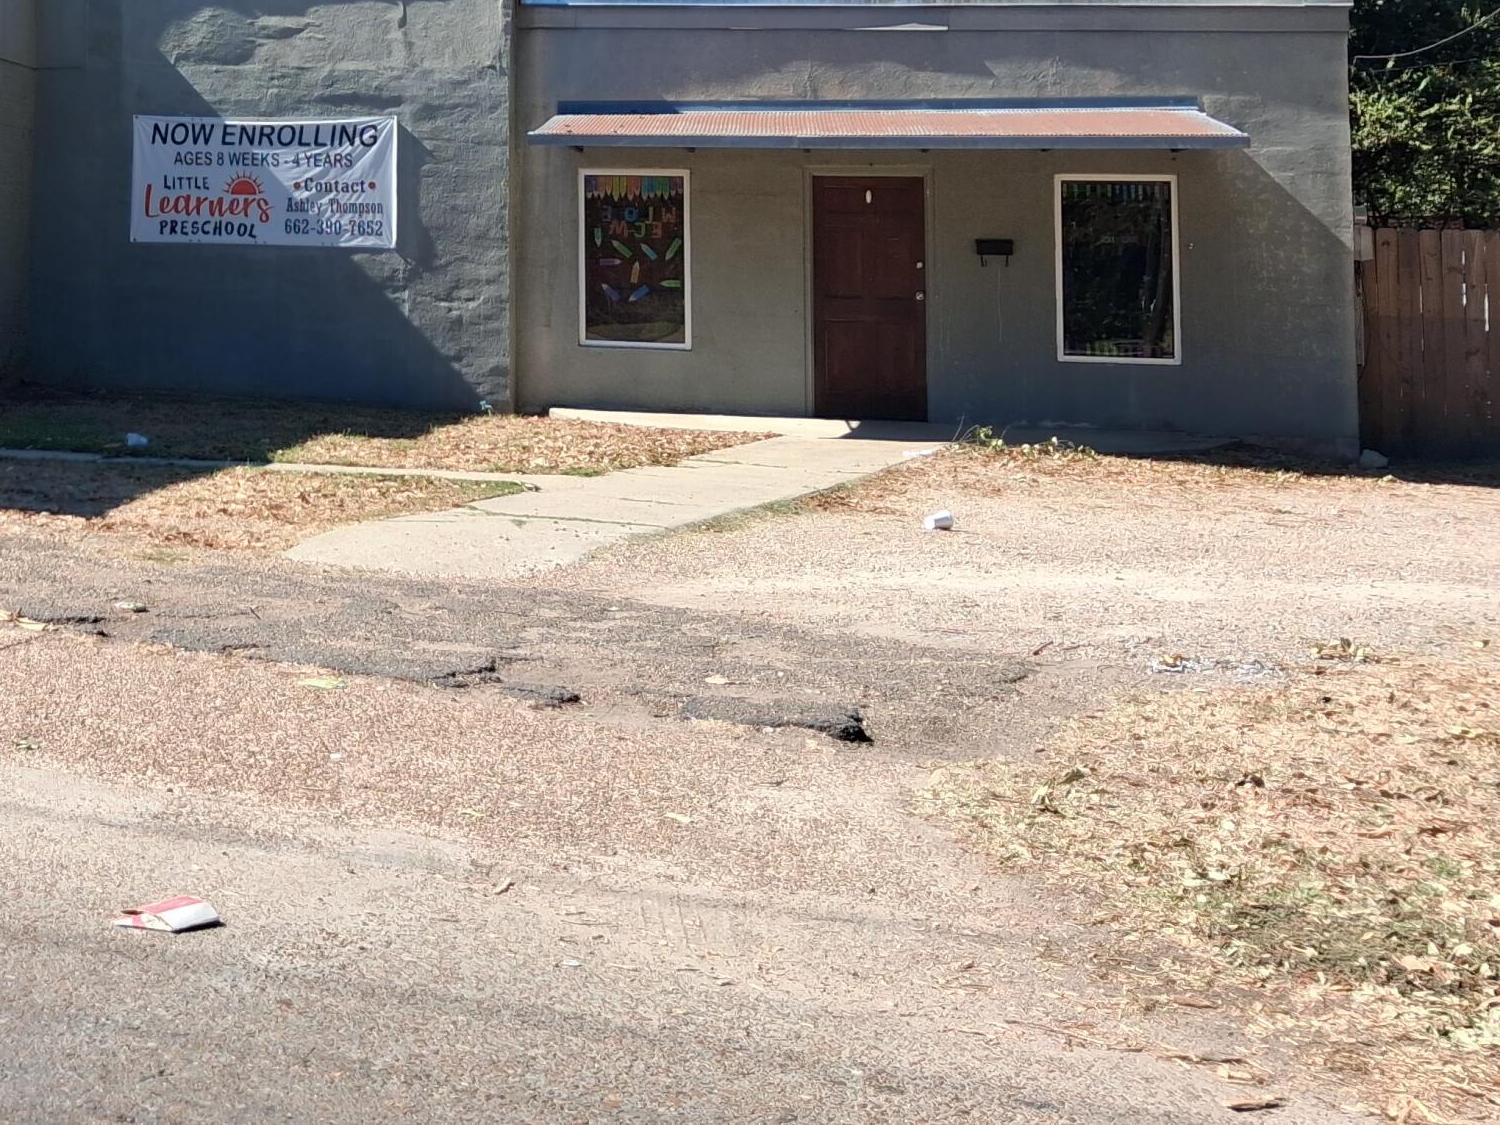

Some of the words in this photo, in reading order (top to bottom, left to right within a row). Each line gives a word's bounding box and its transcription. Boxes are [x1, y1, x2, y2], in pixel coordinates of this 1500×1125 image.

[151, 123, 215, 146] NOW
[221, 124, 379, 148] ENROLLING
[174, 151, 213, 166] AGES
[216, 152, 225, 166] 8
[229, 152, 280, 167] WEEKS
[303, 153, 353, 168] YEARS
[163, 174, 210, 190] LITTLE
[304, 177, 366, 194] Contact
[144, 183, 275, 223] Learners
[286, 197, 321, 216] Ashley
[328, 197, 384, 216] Thompson
[159, 219, 257, 239] PRESCHOOL
[284, 218, 384, 237] 662-390-7652
